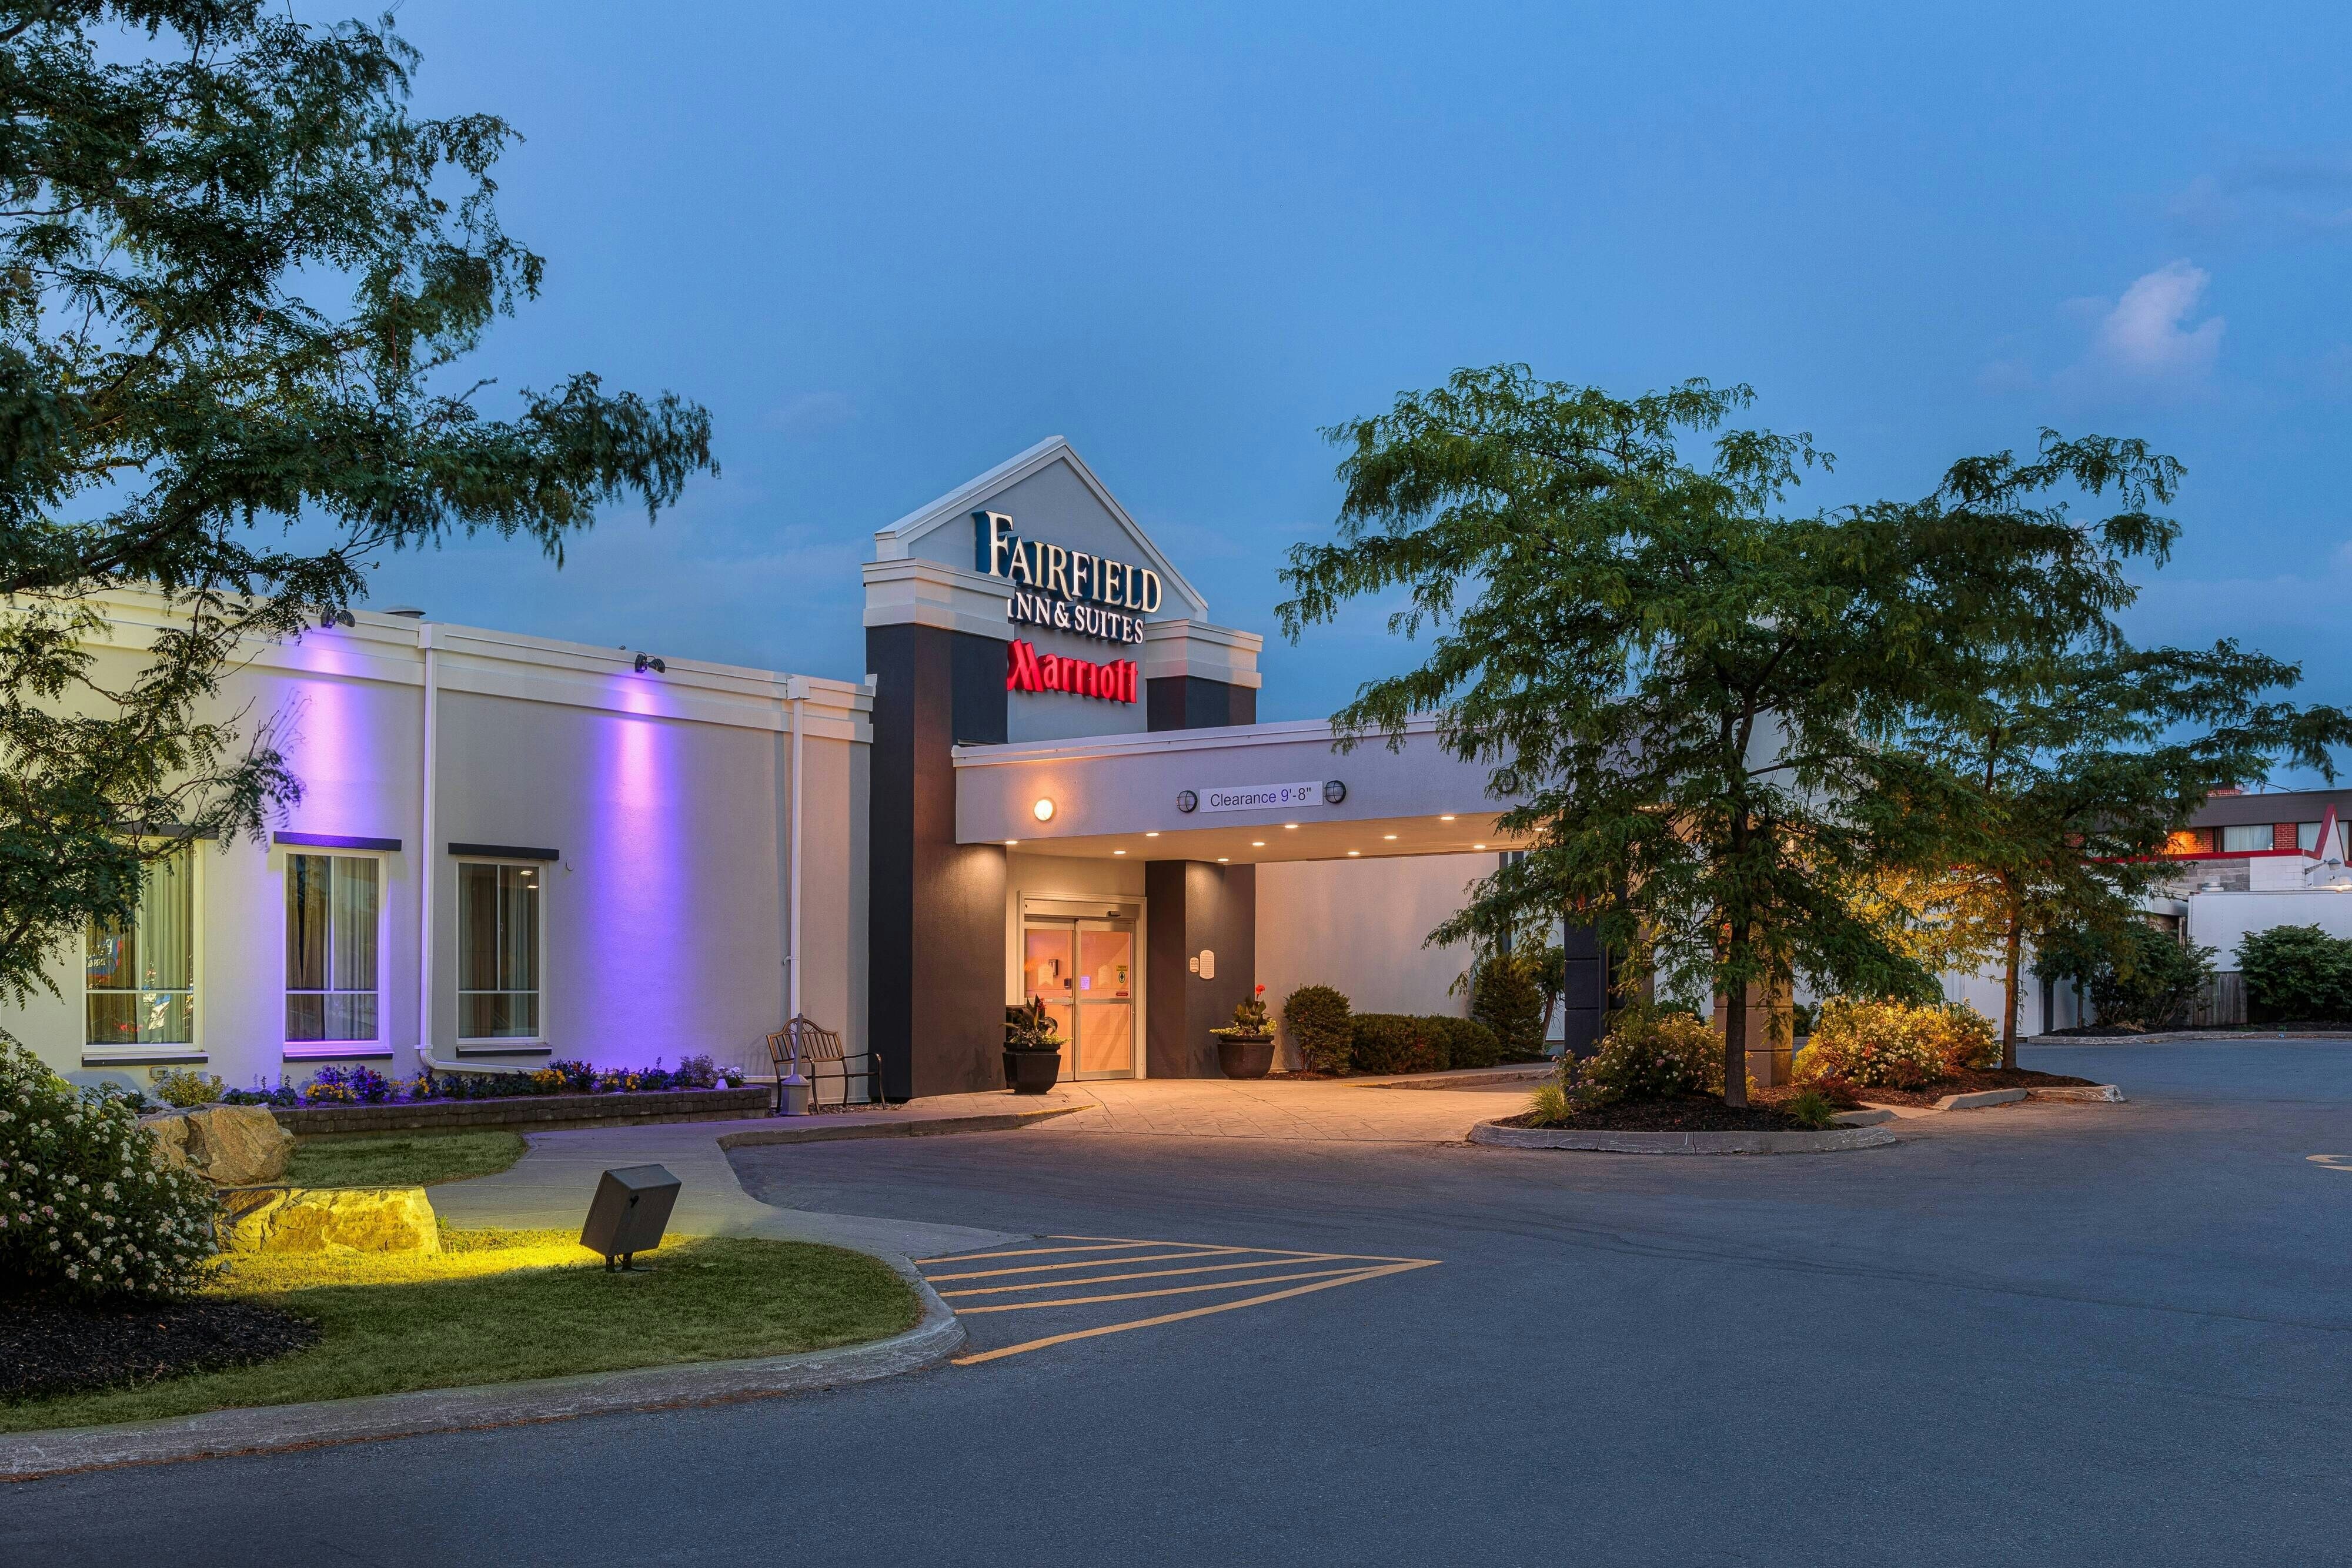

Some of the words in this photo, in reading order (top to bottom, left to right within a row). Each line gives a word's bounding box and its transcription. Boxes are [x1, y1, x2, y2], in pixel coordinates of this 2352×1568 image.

[985, 510, 1162, 613] FAIRFIELD
[1007, 592, 1051, 626] INN
[1054, 601, 1071, 628] &
[1075, 605, 1144, 644] SUITES
[1007, 638, 1138, 703] Marriott
[1210, 793, 1277, 807] Clearance
[1281, 787, 1311, 802] 9'-8"
